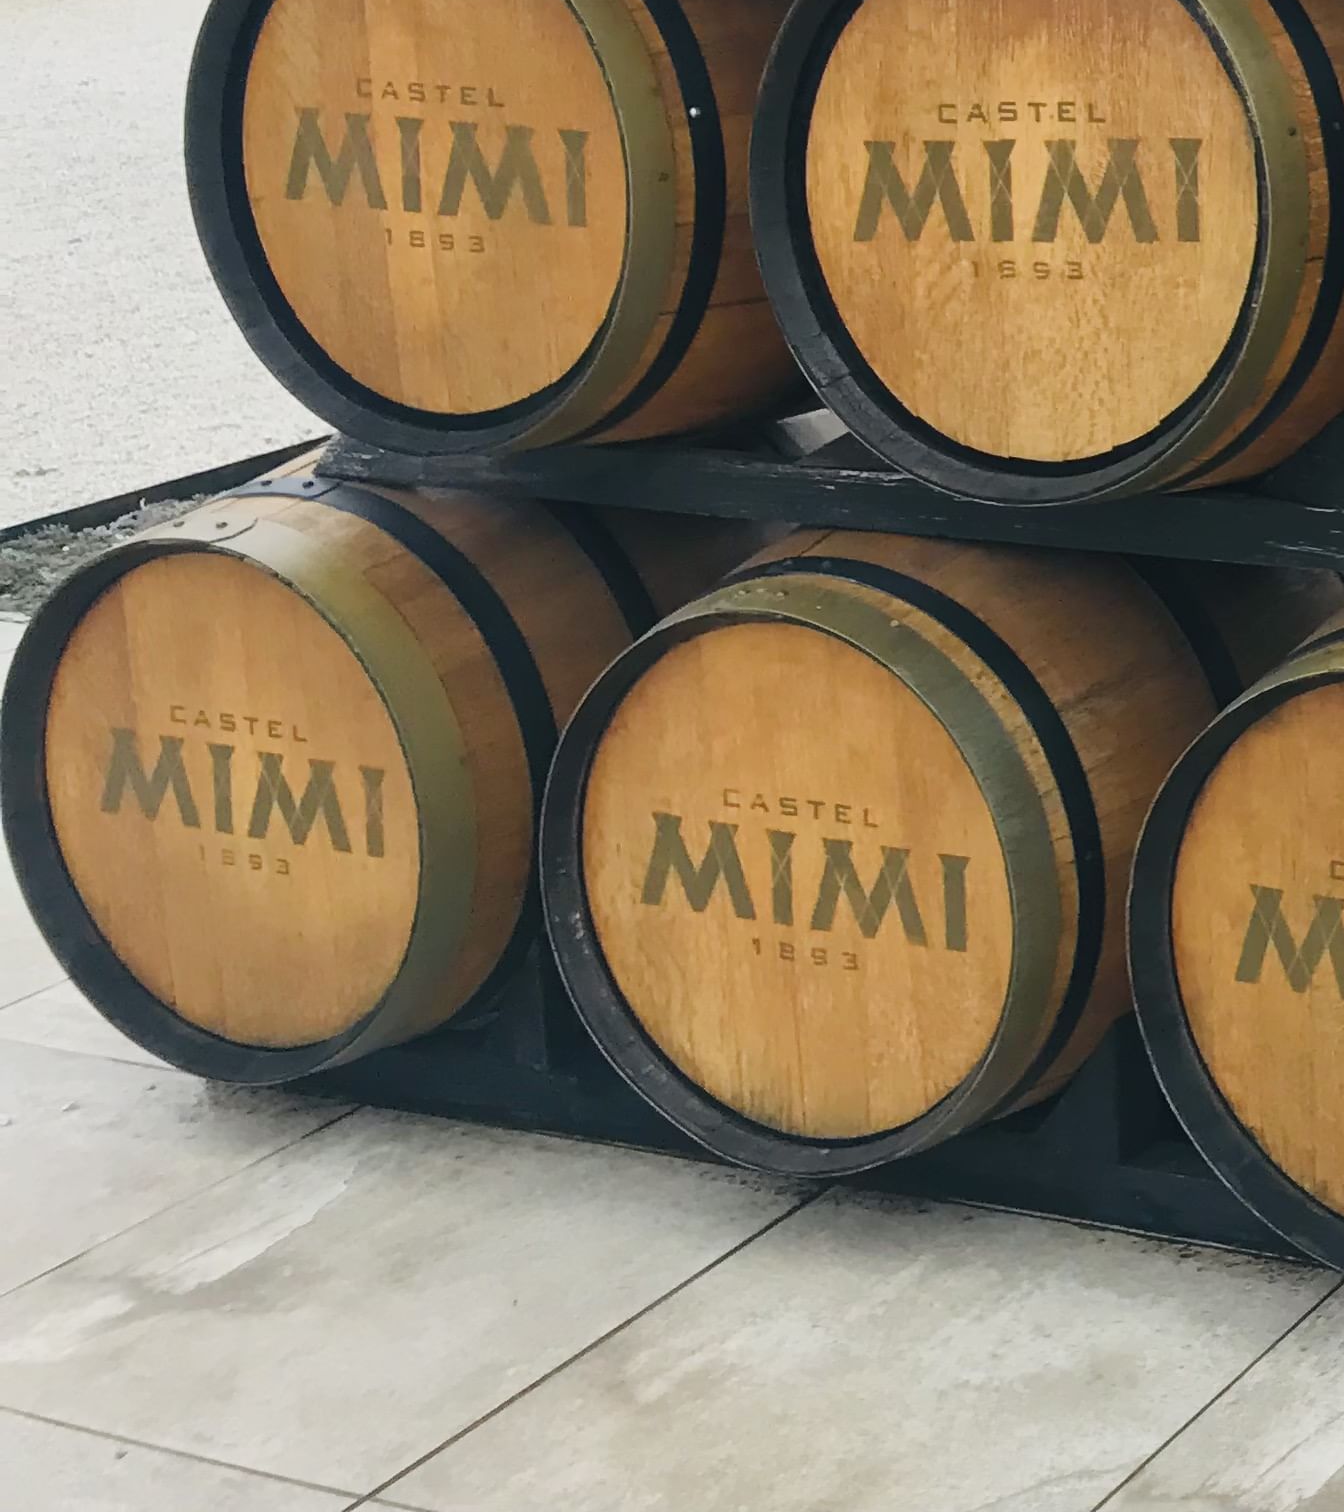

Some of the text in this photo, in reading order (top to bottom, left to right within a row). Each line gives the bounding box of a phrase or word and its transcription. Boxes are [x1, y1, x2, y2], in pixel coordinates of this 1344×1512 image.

[357, 77, 505, 108] CASTEL
[938, 102, 1107, 124] CASTEL
[285, 107, 589, 227] MIMI
[853, 138, 1202, 243] MIMI
[385, 229, 487, 254] 1893
[170, 705, 308, 743] CASTEL
[101, 728, 385, 858] MIMI
[723, 789, 880, 828] CASTEL
[641, 813, 970, 952] MIMI
[753, 938, 860, 970] 1893
